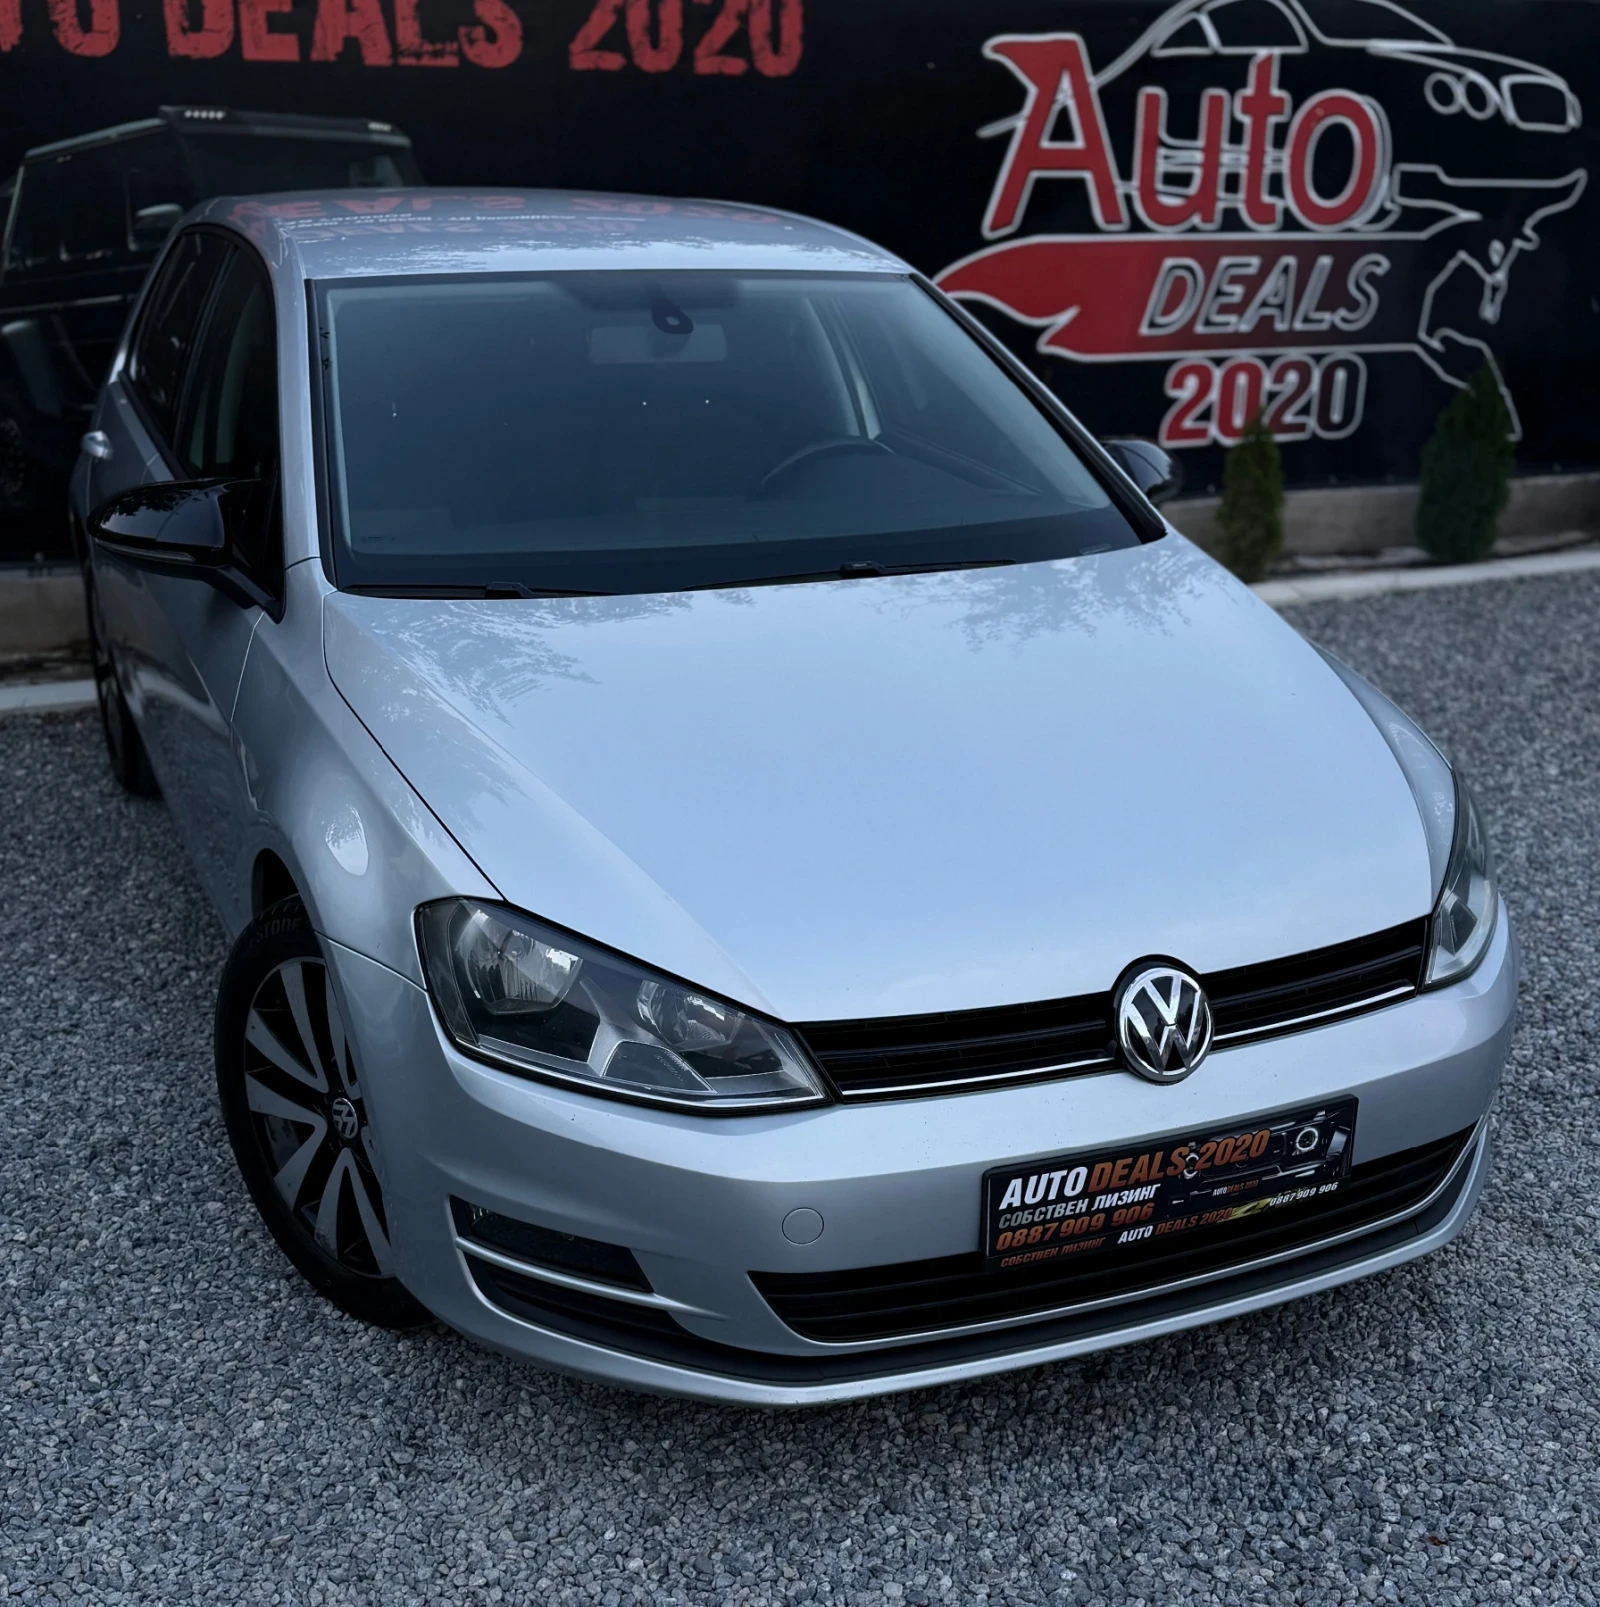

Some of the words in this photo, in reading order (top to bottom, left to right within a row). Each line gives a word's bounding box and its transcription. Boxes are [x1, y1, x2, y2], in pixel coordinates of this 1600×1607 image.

[163, 0, 524, 69] DEALS
[568, 0, 804, 78] 2020
[983, 33, 1388, 238] Auto
[1139, 254, 1391, 336] DEALS
[1159, 353, 1367, 448] 2020
[999, 1166, 1088, 1210] AUTO
[1088, 1147, 1189, 1193] DEALS
[1195, 1129, 1270, 1171] 2020
[1318, 1181, 1339, 1194] 906
[999, 1199, 1089, 1229] СОБСТВЕН
[1091, 1184, 1161, 1211] ЛИЗИНГ
[1111, 1202, 1155, 1227] 906
[1117, 1226, 1153, 1244] AUTO
[1155, 1215, 1198, 1235] DEALS
[1199, 1207, 1234, 1226] 2020
[1001, 1247, 1059, 1268] СОБСТВЕН
[1060, 1237, 1106, 1256] ЛИЗИНГ
